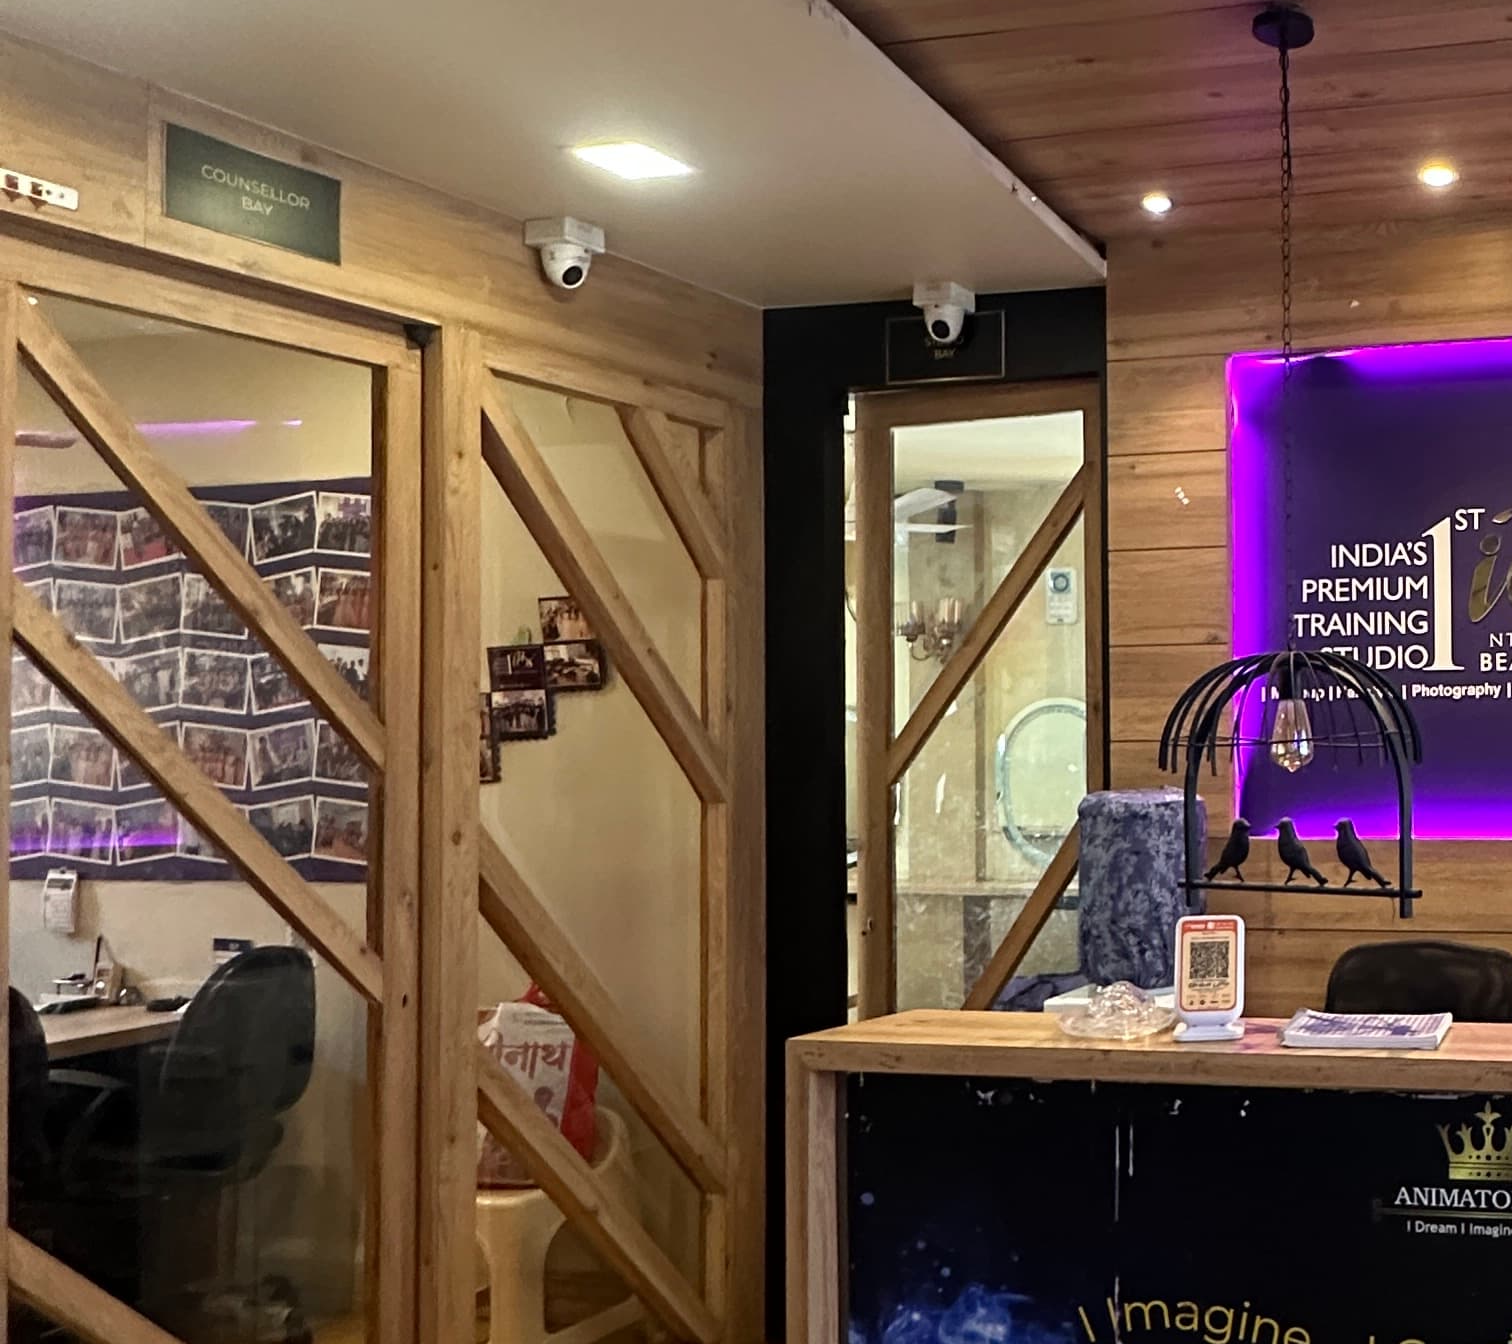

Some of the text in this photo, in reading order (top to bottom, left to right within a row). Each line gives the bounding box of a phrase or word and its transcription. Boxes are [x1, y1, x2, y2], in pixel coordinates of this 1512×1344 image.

[201, 164, 310, 210] COUNSELLOR
[242, 196, 273, 216] BAY
[1331, 541, 1428, 568] INDIA'S
[1302, 575, 1428, 603] PREMIUM
[1293, 610, 1428, 638] TRAINING
[1320, 644, 1429, 670] TUDIO
[1411, 682, 1502, 699] Photography
[1415, 1221, 1458, 1235] Dream
[1078, 1306, 1096, 1343] I
